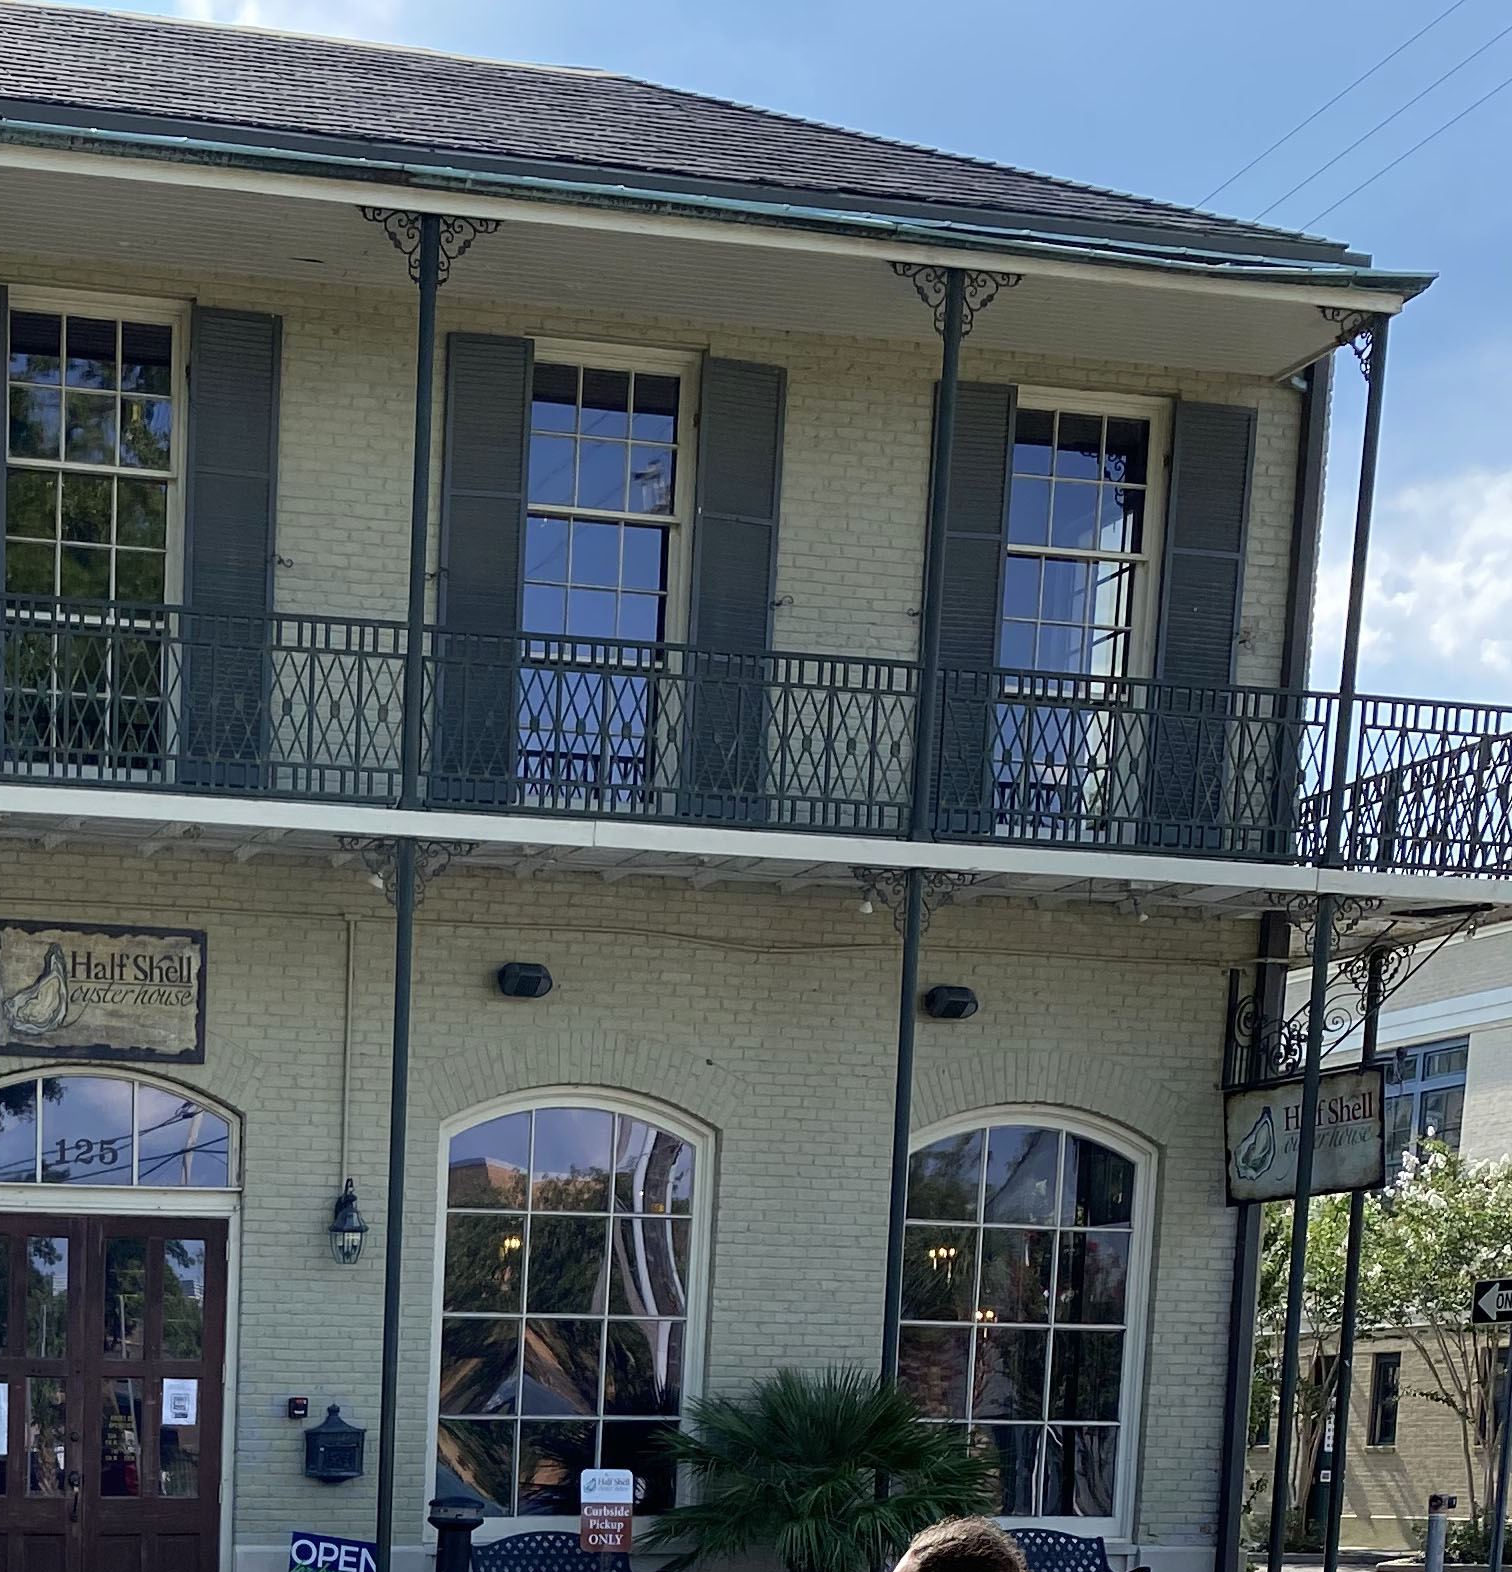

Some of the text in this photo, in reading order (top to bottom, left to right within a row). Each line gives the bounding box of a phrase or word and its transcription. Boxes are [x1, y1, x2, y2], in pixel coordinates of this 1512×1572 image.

[70, 951, 193, 984] Half Shell
[1283, 1091, 1374, 1132] Hf Shell
[55, 1138, 118, 1165] 125
[583, 1505, 630, 1517] Curbside
[589, 1519, 624, 1533] Pickup
[588, 1534, 624, 1545] ONLY
